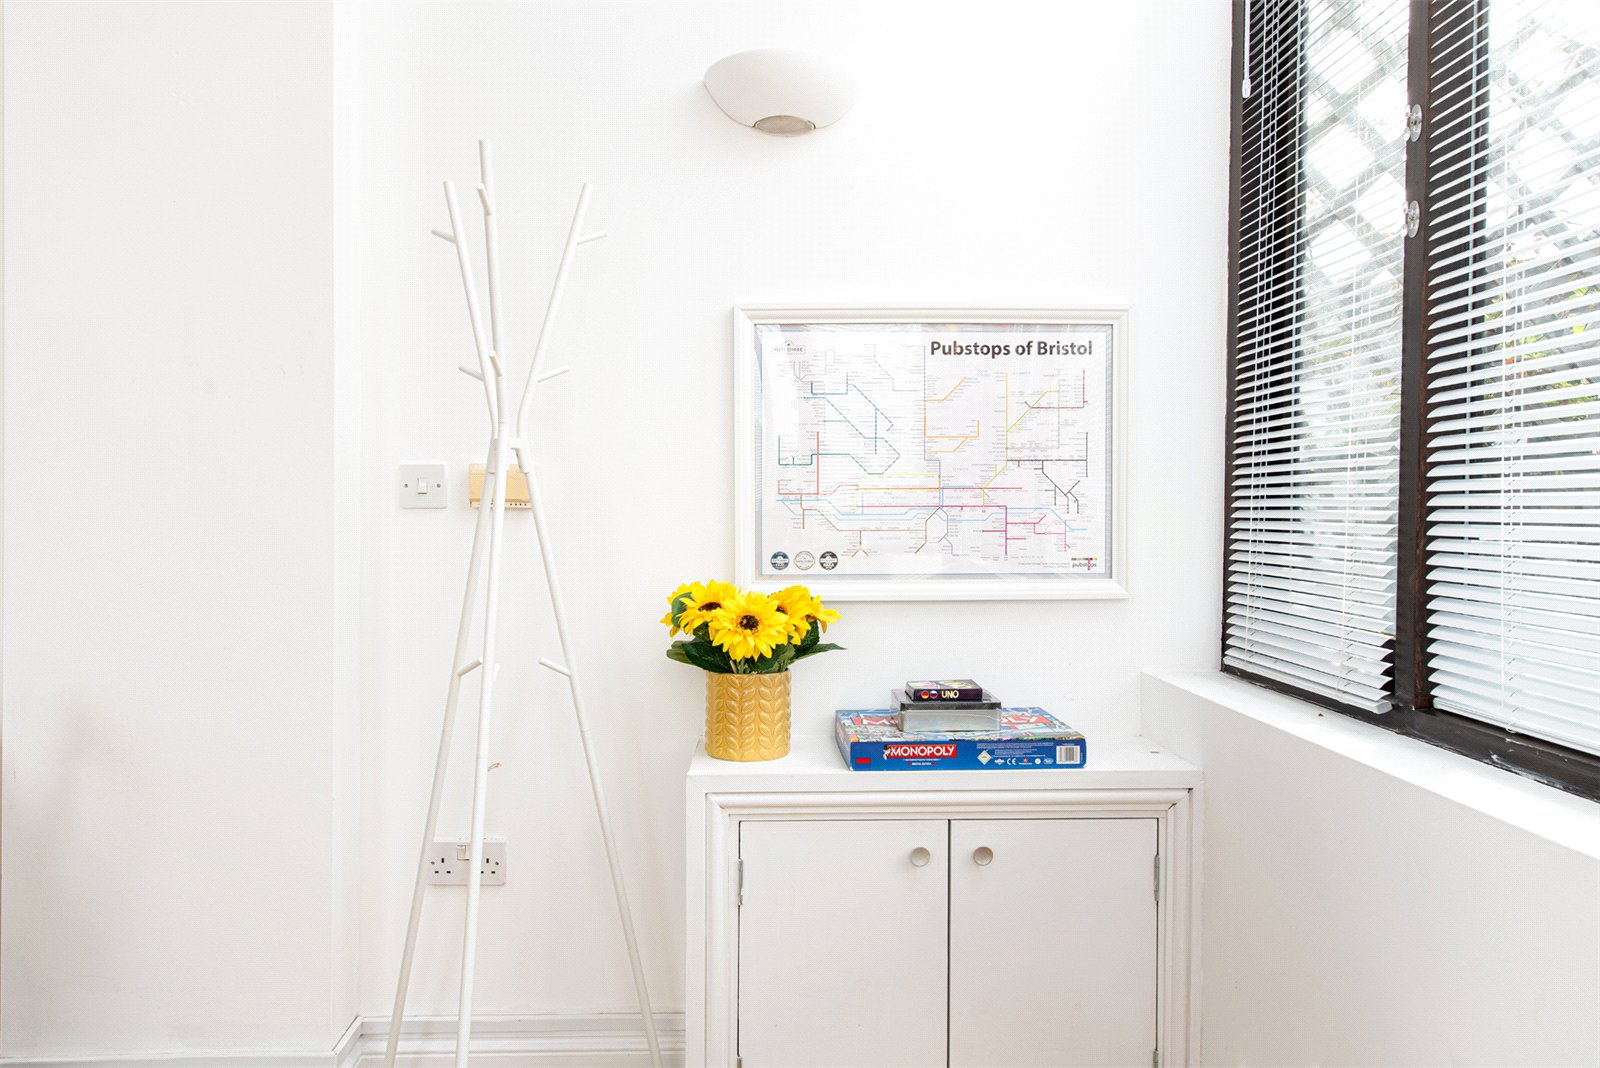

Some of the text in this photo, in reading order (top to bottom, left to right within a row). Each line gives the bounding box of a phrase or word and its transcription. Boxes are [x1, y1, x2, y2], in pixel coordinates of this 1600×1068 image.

[930, 340, 1093, 359] Pubstops of Bristol
[941, 689, 960, 699] UNO
[890, 745, 955, 757] MONOPOLY
